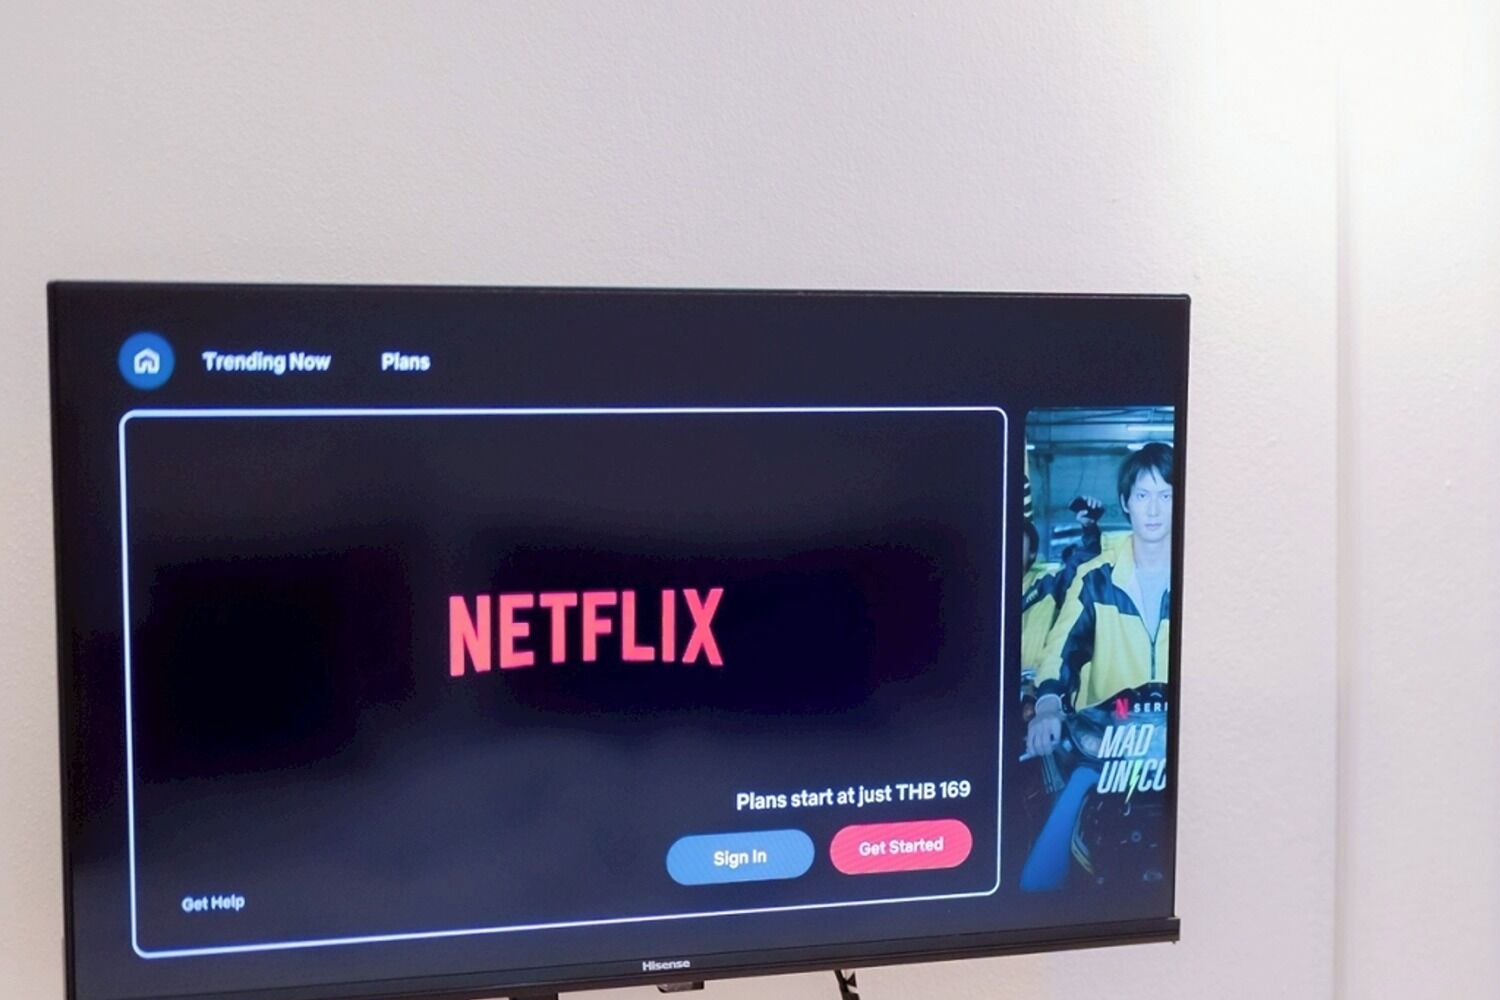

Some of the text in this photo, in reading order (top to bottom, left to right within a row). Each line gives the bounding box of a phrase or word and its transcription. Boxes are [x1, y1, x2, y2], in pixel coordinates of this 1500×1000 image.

[202, 351, 331, 375] Trending Now
[381, 352, 430, 371] Plans
[449, 588, 724, 677] NETFLIX
[1097, 724, 1154, 758] MAD
[736, 780, 971, 811] Plans start at just THB 169
[859, 836, 944, 856] Get Started
[713, 849, 767, 869] Sign In
[182, 893, 245, 912] Get Help
[642, 960, 690, 971] Hisense
